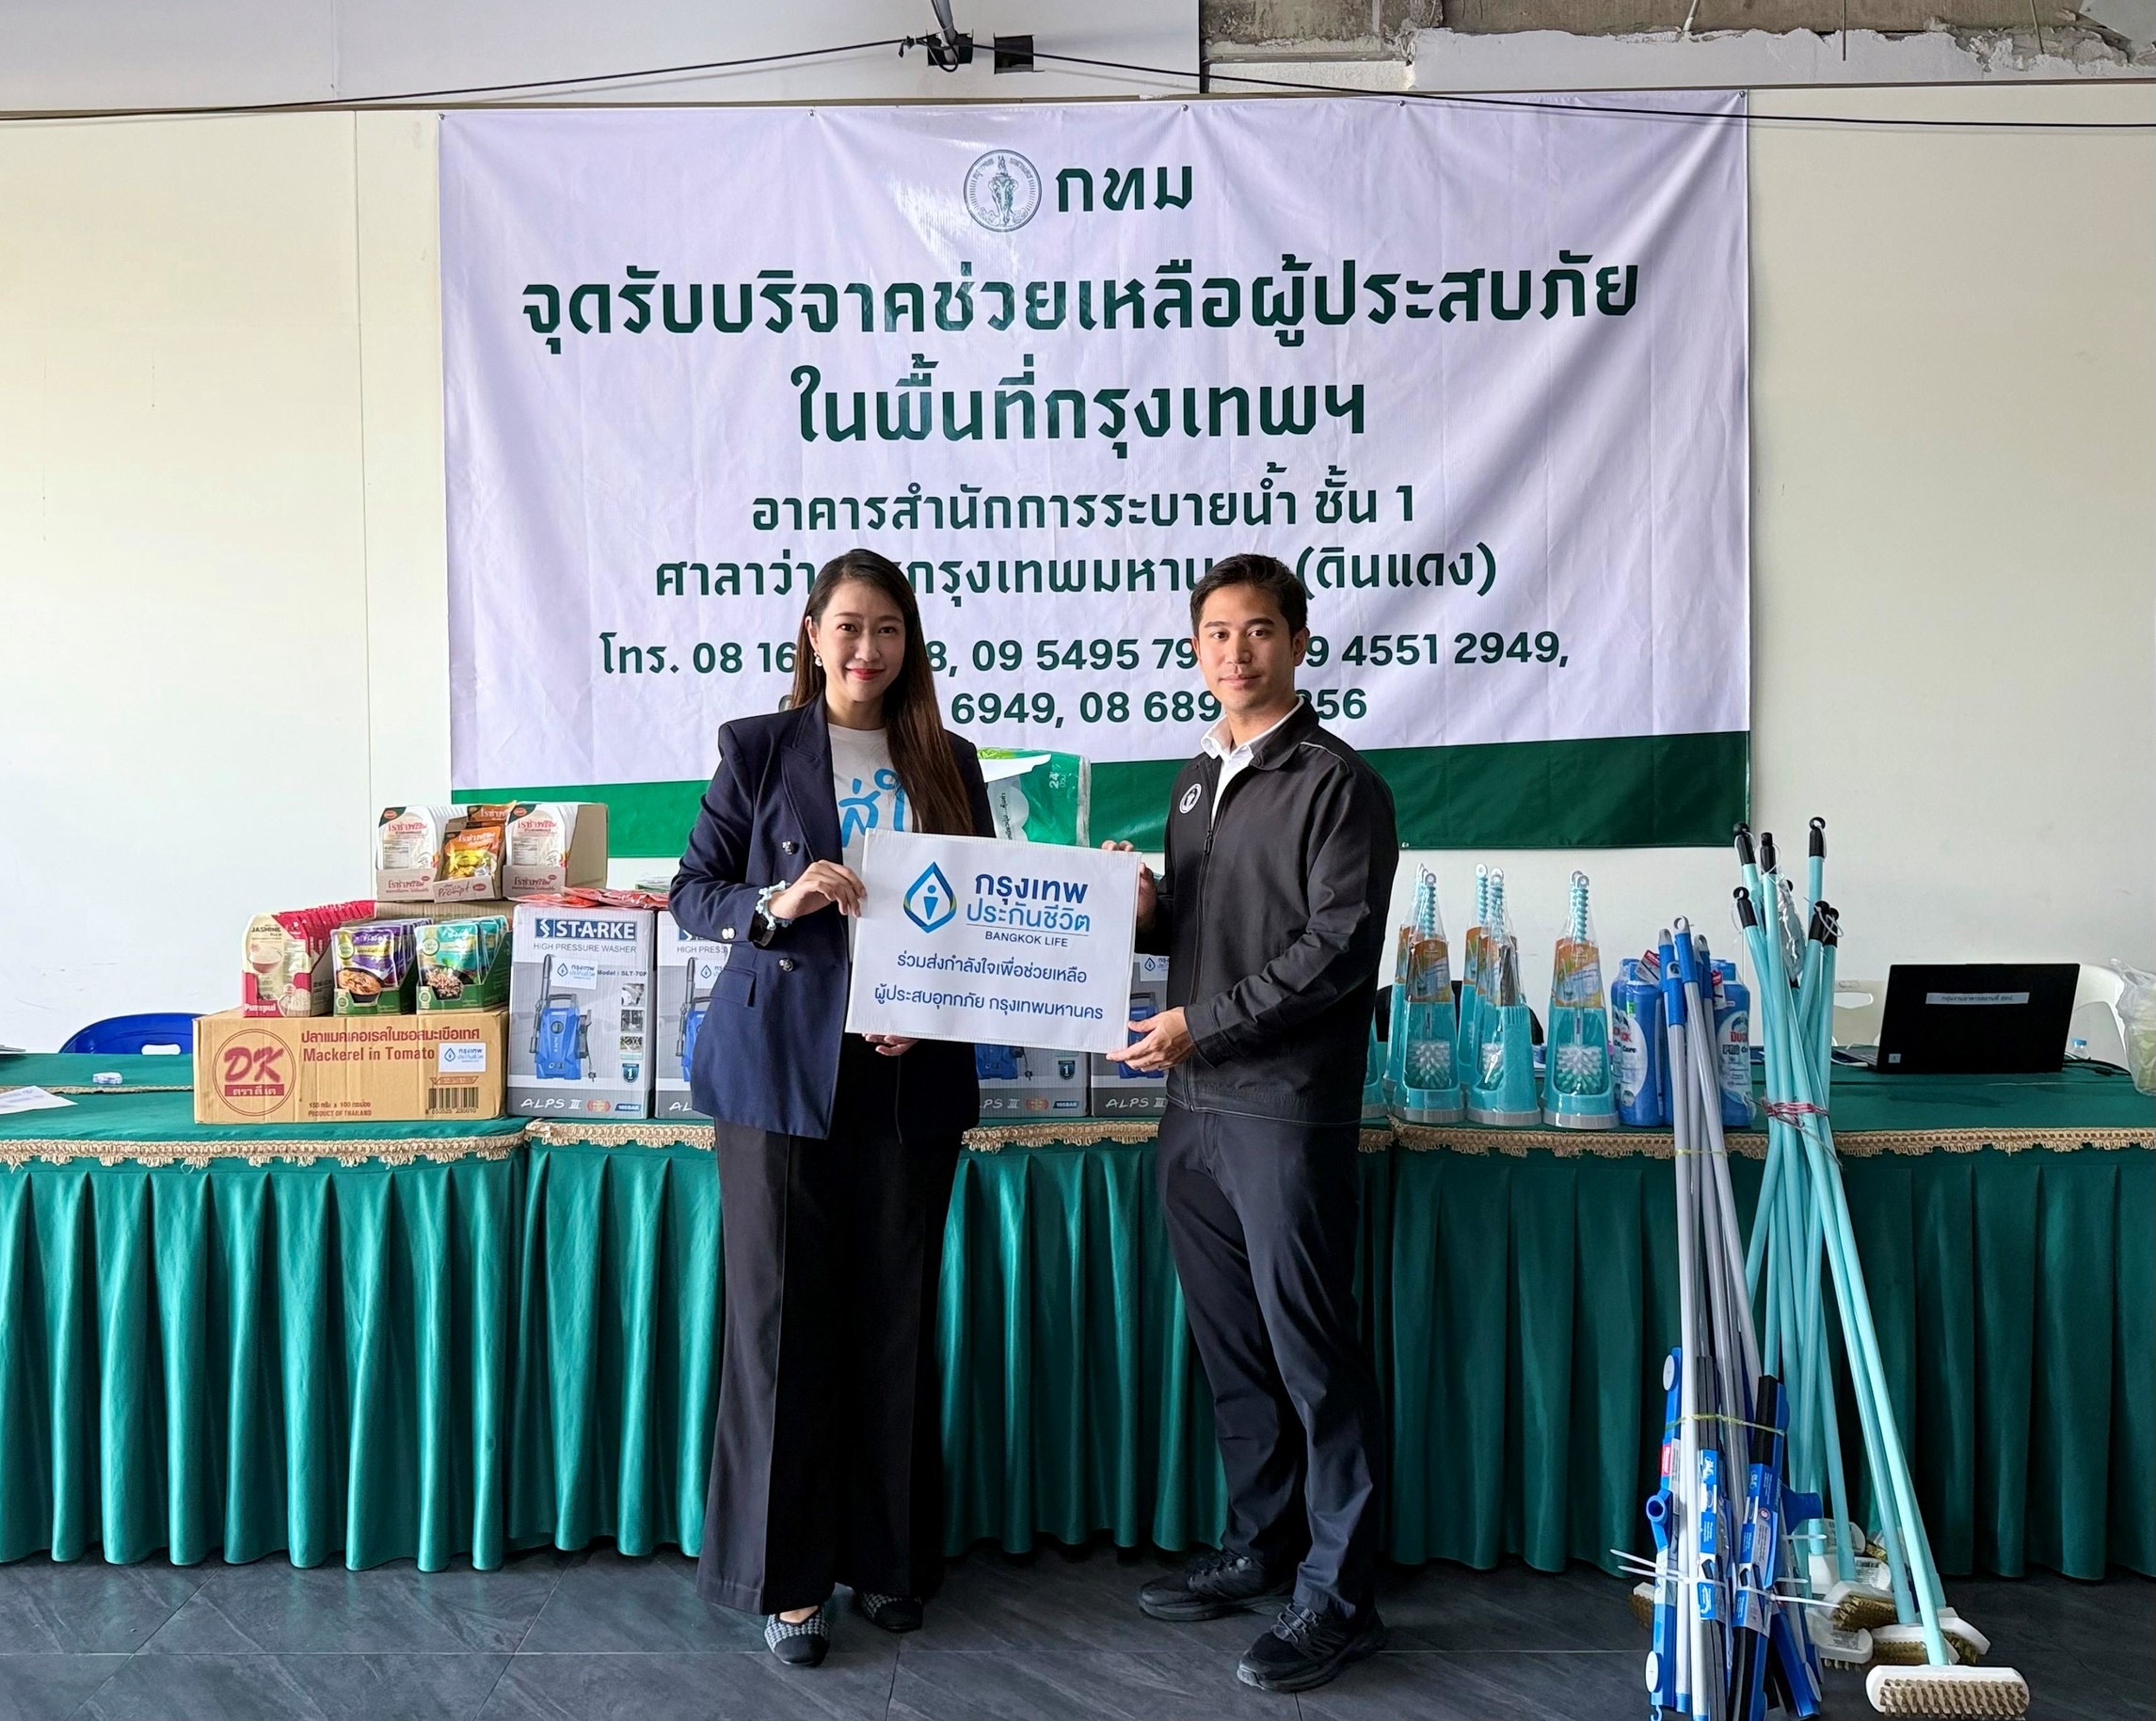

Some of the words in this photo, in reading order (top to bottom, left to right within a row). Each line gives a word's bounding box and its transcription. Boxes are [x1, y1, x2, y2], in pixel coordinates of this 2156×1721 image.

[1055, 165, 1193, 213] กทม
[522, 249, 1638, 354] จุดรับบริจาคช่วยเหลือผู้ประสบภัย
[791, 353, 1365, 459] ในพื้นที่กรุงเทพฯ
[752, 462, 1297, 531] อาคารสำนักการระบายน้ำ
[1316, 465, 1378, 524] ชั้น
[1396, 485, 1413, 522] 1
[1296, 541, 1496, 599] (ดินแดง)
[599, 631, 679, 674] โทร.
[693, 642, 743, 673] 08
[758, 643, 796, 673] 16
[972, 641, 1024, 671] 09
[1037, 640, 1140, 671] 5495
[1152, 637, 1197, 670] 79
[1305, 635, 1330, 667] 9
[1341, 633, 1437, 667] 4551
[1454, 630, 1569, 669] 2949,
[951, 692, 1064, 728] 6949,
[1079, 691, 1129, 723] 08
[1143, 690, 1222, 723] 689
[975, 873, 1089, 906] กรุงเทพ
[966, 897, 1091, 932] ประกันชีวิต
[556, 943, 600, 952] PRESSURE
[600, 945, 637, 953] WASHER
[985, 931, 1042, 945] BANGKOK
[1045, 935, 1069, 948] LIFE
[897, 950, 1087, 983] ร่วมส่งกำลังใจเพื่อช่วยเหลือ
[874, 984, 985, 1011] ผู้ประสบอุทกภัย
[988, 997, 1104, 1020] กรุงเทพมหานคร
[301, 1026, 480, 1044] ปลาแมคเคอเรลในซอสมะเขือเทศ
[224, 1045, 284, 1083] DK
[302, 1047, 365, 1062] Mackerel
[368, 1046, 382, 1061] in
[386, 1046, 436, 1061] Tomato
[520, 1098, 566, 1109] ALPS
[1105, 1097, 1150, 1108] ALPS
